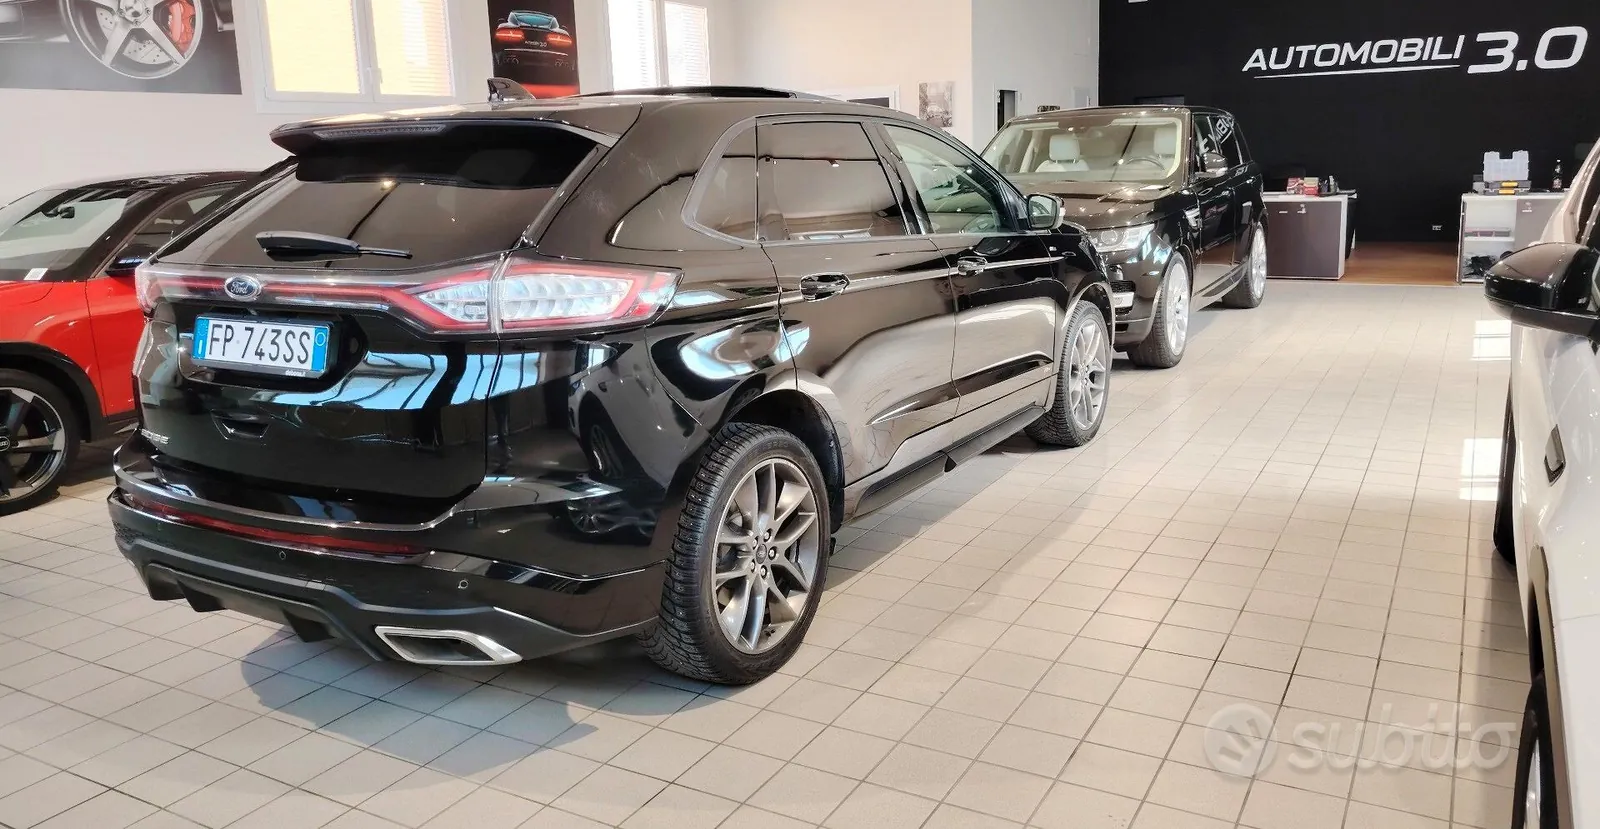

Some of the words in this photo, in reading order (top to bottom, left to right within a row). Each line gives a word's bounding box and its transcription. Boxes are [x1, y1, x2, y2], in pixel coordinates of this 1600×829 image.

[1242, 34, 1465, 72] AUTOMOBILI
[1467, 26, 1589, 74] 3.0
[230, 281, 249, 295] Ford
[209, 323, 235, 356] FP
[241, 326, 311, 364] 743SS
